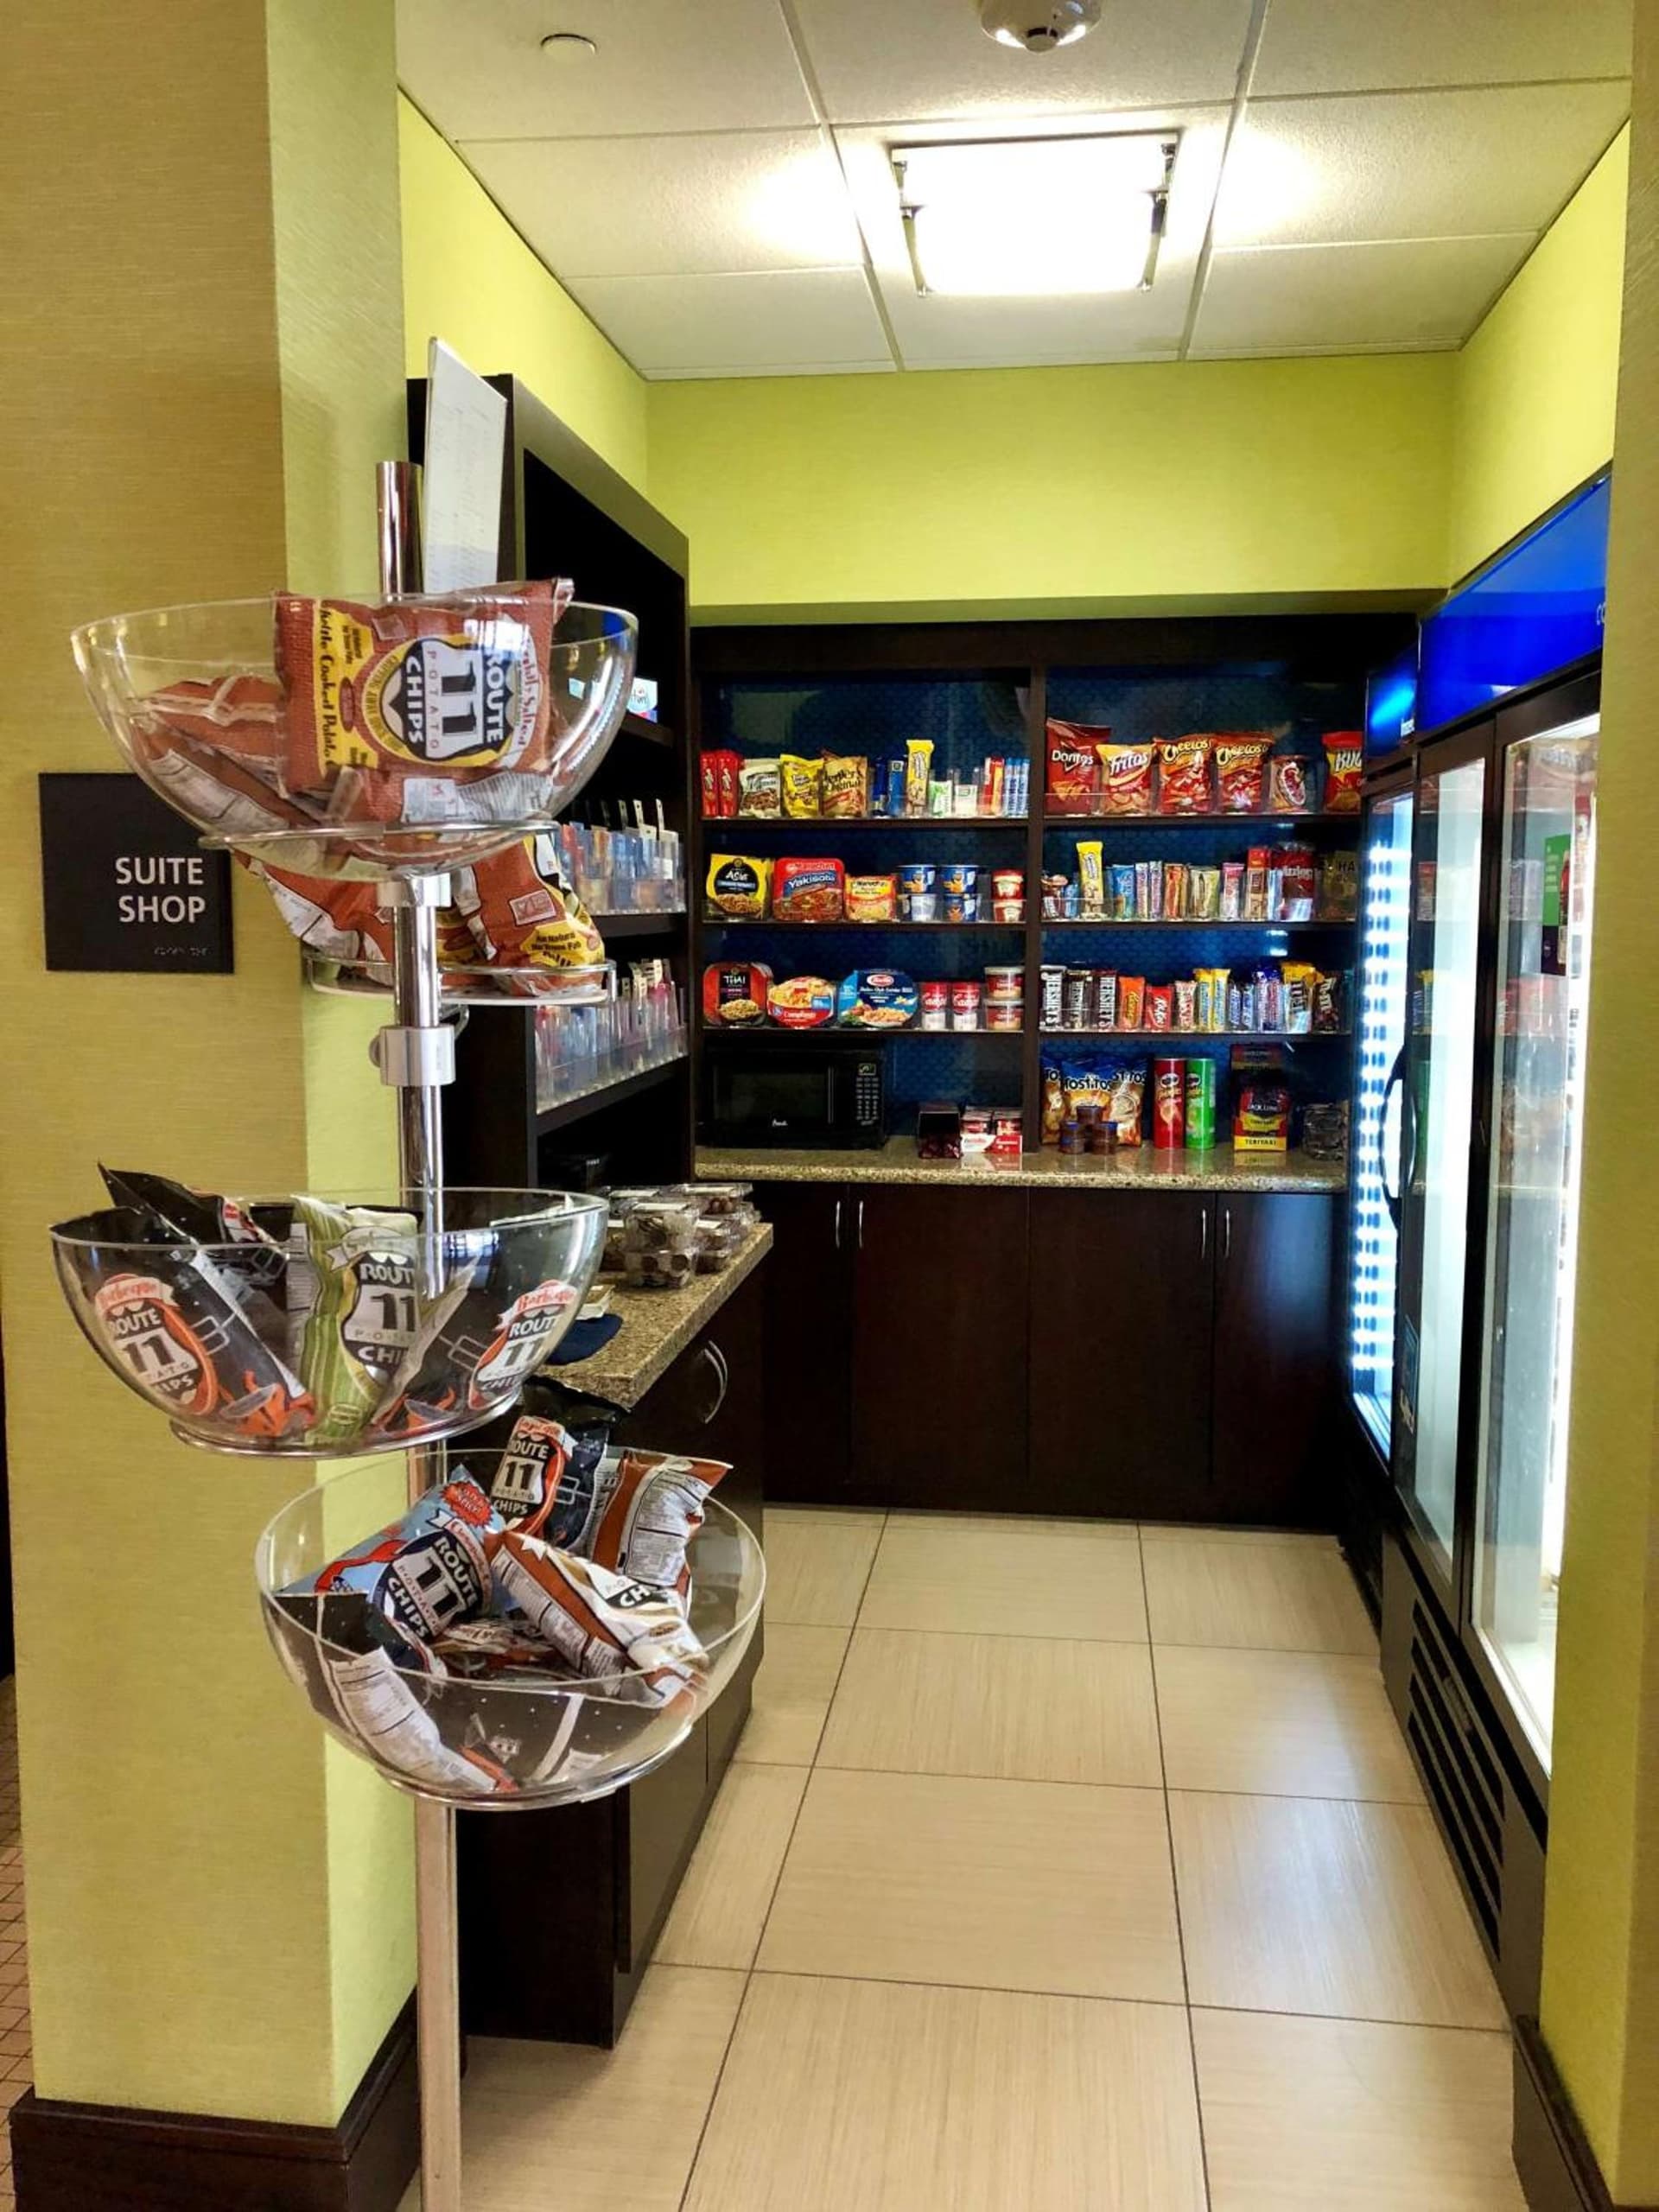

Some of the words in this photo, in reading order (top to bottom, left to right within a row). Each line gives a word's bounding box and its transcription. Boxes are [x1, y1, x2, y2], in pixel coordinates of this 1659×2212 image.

[319, 653, 335, 711] Cooked
[405, 655, 424, 744] CHIPS
[441, 659, 477, 734] 11
[486, 651, 505, 744] ROUTE
[320, 713, 338, 753] Potato
[1163, 739, 1209, 763] Cheetos
[1052, 749, 1094, 766] Doritos
[115, 856, 204, 885] SUITE
[787, 872, 836, 889] Yakisoba
[118, 895, 207, 923] SHOP
[1098, 976, 1116, 1031] HERSHEY'S
[359, 1262, 416, 1286] ROUT
[493, 1498, 529, 1516] CHIPS
[416, 1556, 459, 1618] 11
[435, 1535, 479, 1611] ROUTE
[388, 1576, 430, 1639] CHIPS
